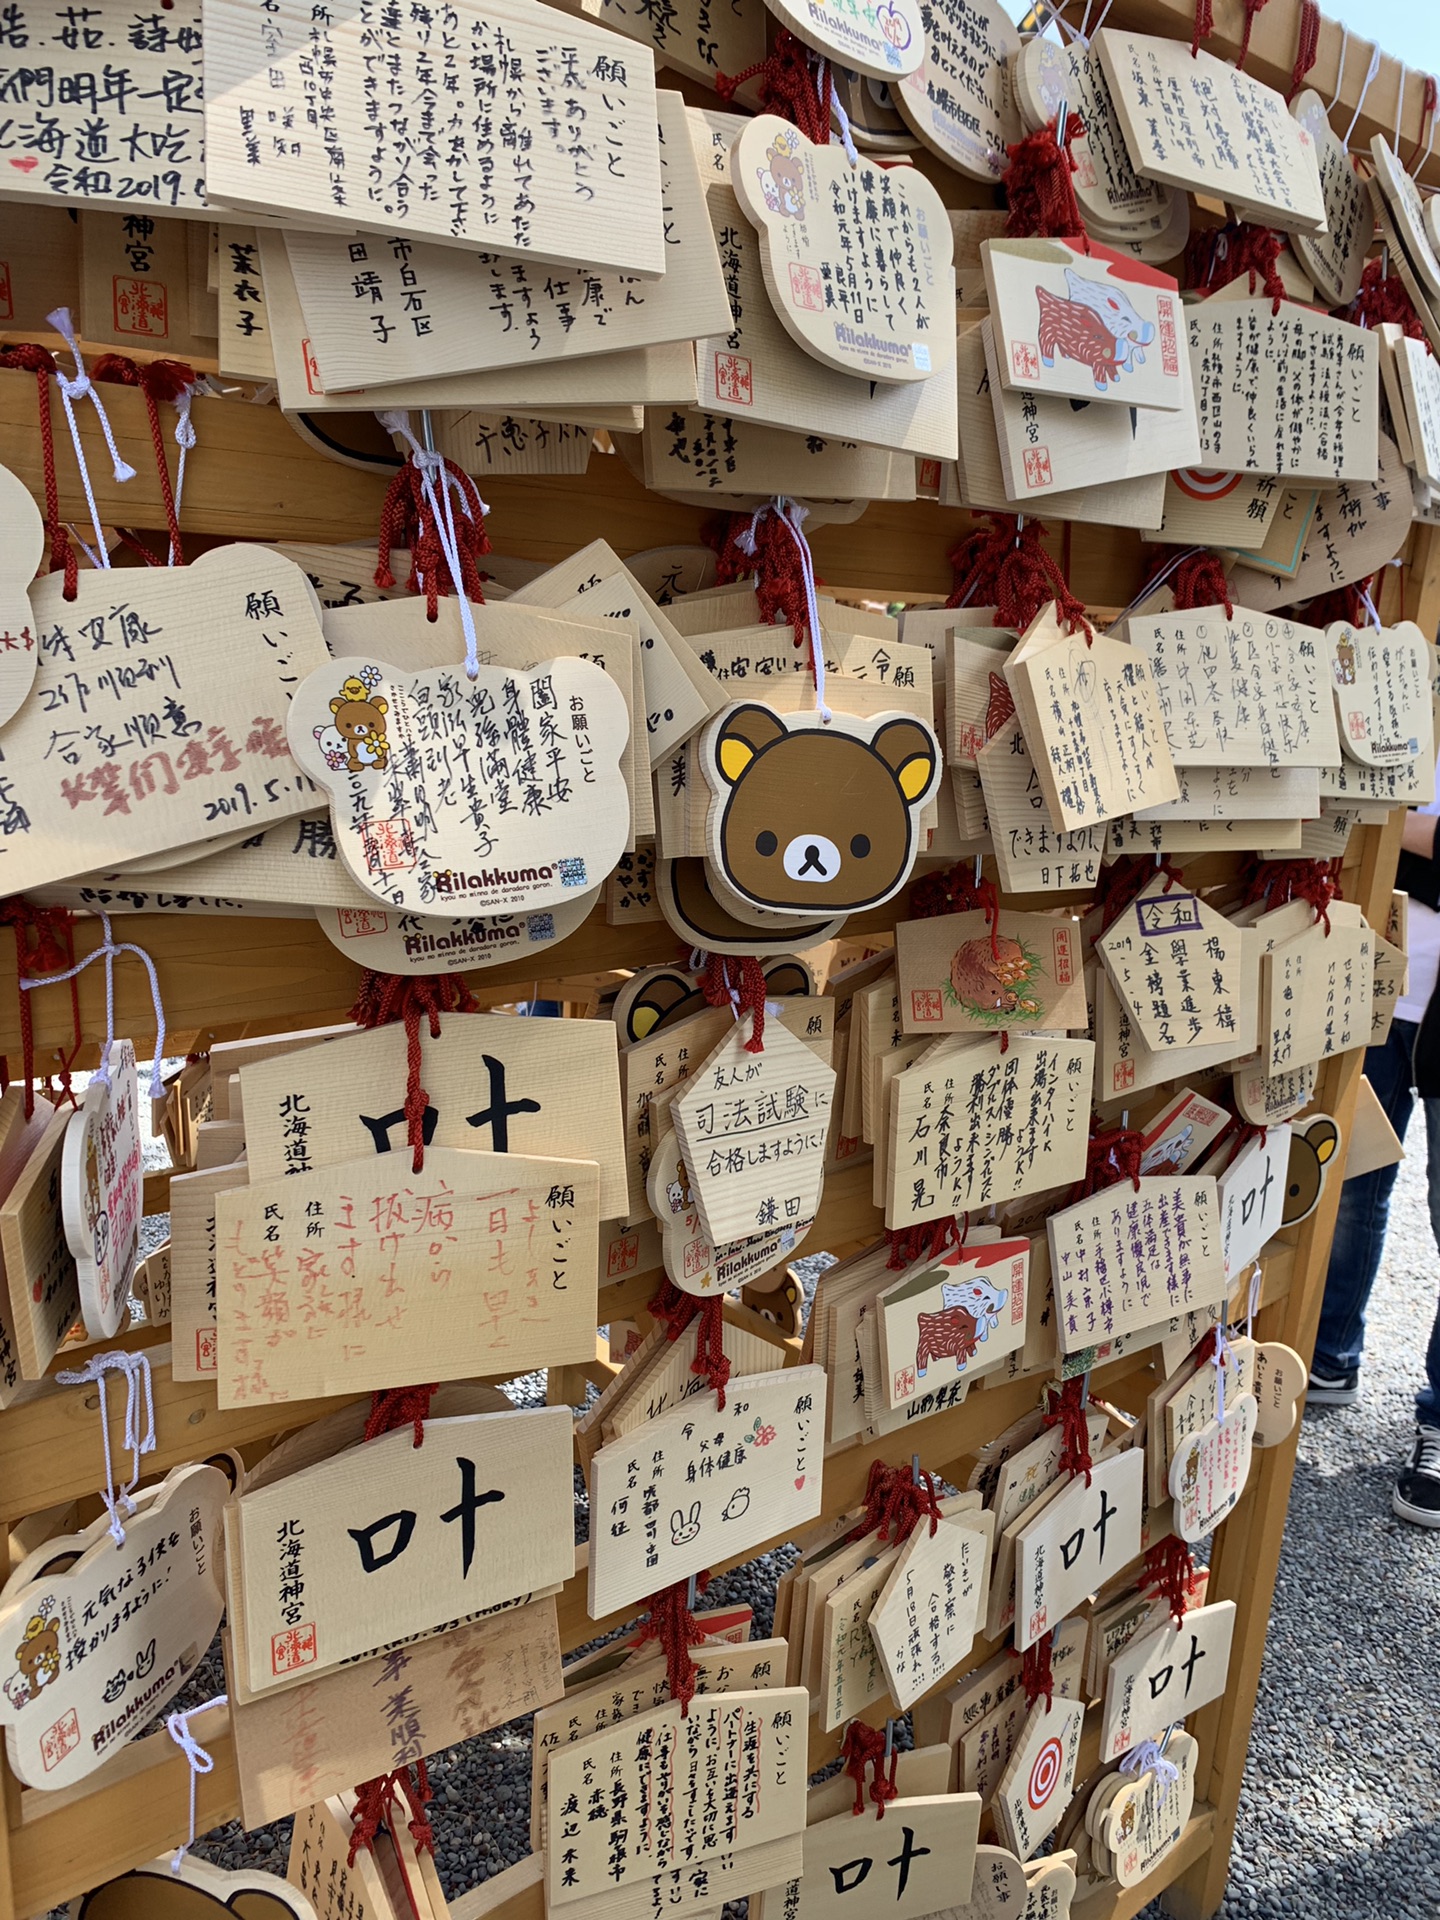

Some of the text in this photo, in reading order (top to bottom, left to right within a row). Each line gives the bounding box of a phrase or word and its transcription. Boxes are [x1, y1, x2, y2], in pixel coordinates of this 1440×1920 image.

[592, 56, 628, 178] 願いごと
[712, 133, 727, 171] 氏名
[843, 173, 878, 312] いけますように
[899, 184, 931, 329] これからも2人が
[1190, 320, 1201, 347] 氏名
[1212, 323, 1223, 350] 住所
[1347, 344, 1365, 422] 願いごと
[245, 589, 298, 700] 願いご
[1154, 628, 1165, 653] 氏名
[1175, 630, 1186, 655] 住所
[1300, 642, 1319, 713] 願いごと
[569, 695, 596, 783] お願いごと
[1146, 902, 1192, 929] 令和
[654, 1053, 667, 1084] 氏名
[677, 1048, 690, 1078] 住所
[713, 1063, 763, 1091] 友人が
[696, 1084, 828, 1135] 司法試験に
[923, 1082, 934, 1109] 氏名
[945, 1079, 955, 1104] 住所
[1066, 1058, 1081, 1131] 願いごと
[706, 1128, 824, 1176] 合格しますように!
[264, 1203, 284, 1242] 氏名
[305, 1201, 325, 1238] 住所
[755, 1197, 801, 1225] 鎌田
[1075, 1221, 1084, 1244] 氏名
[1092, 1217, 1102, 1240] 住所
[1194, 1191, 1209, 1257] 願いごと
[545, 1185, 575, 1291] 願いごと
[794, 1394, 812, 1472] 願いごと
[627, 1459, 640, 1489] 氏名
[652, 1450, 664, 1479] 住所
[346, 1457, 506, 1580] 叶
[1060, 1490, 1117, 1571] 叶
[188, 1506, 207, 1576] お願いごと
[276, 1519, 305, 1626] 北海道神宮
[1148, 1634, 1206, 1700] 叶
[610, 1752, 623, 1778] 住所
[771, 1710, 792, 1785] 願いごと
[582, 1758, 596, 1785] 氏名
[829, 1826, 931, 1901] 叶
